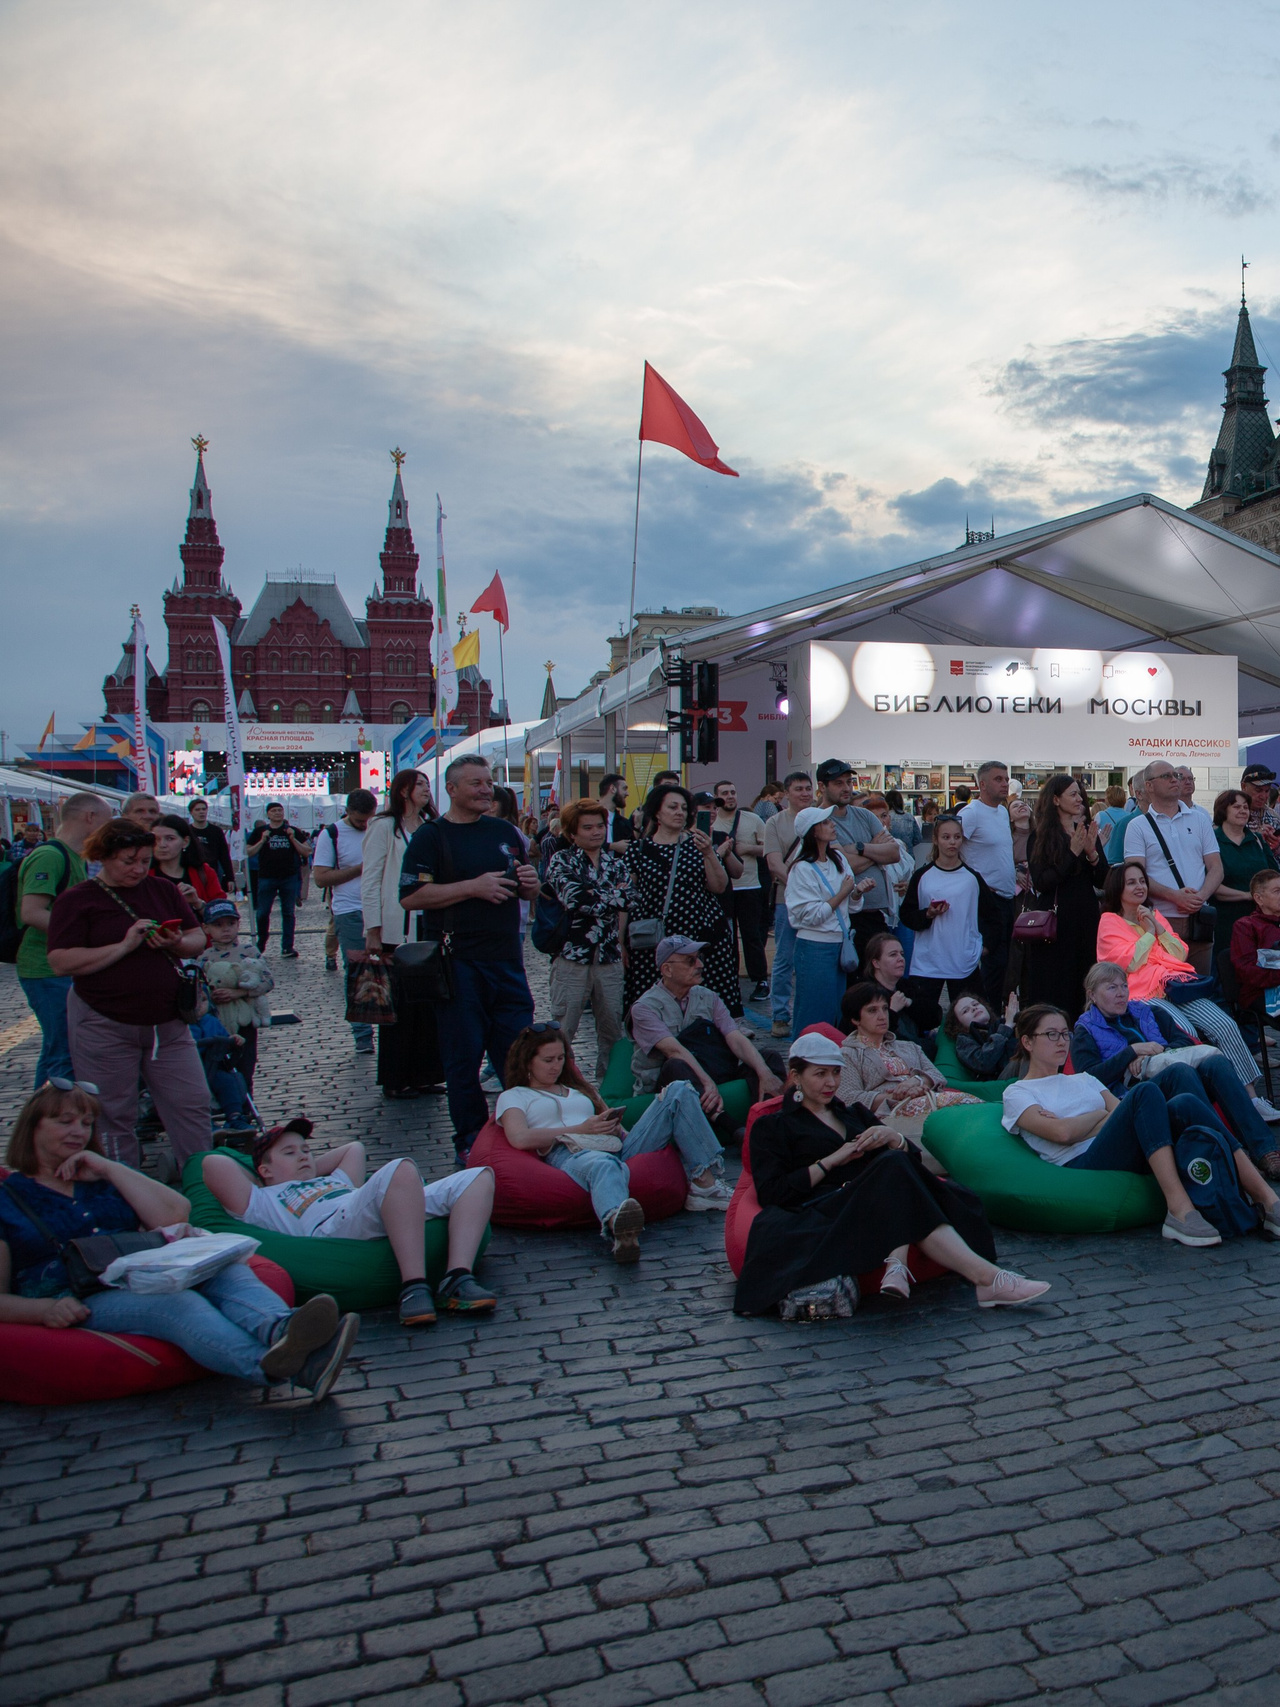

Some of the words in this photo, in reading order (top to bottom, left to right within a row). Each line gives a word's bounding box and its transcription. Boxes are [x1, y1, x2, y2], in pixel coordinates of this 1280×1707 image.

[874, 694, 1062, 714] БИБЛИОТЕКИ
[1090, 698, 1202, 716] МОСКВЫ
[1128, 738, 1172, 748] ЗАГАДКИ
[1174, 739, 1231, 748] КЛАССИКОВ
